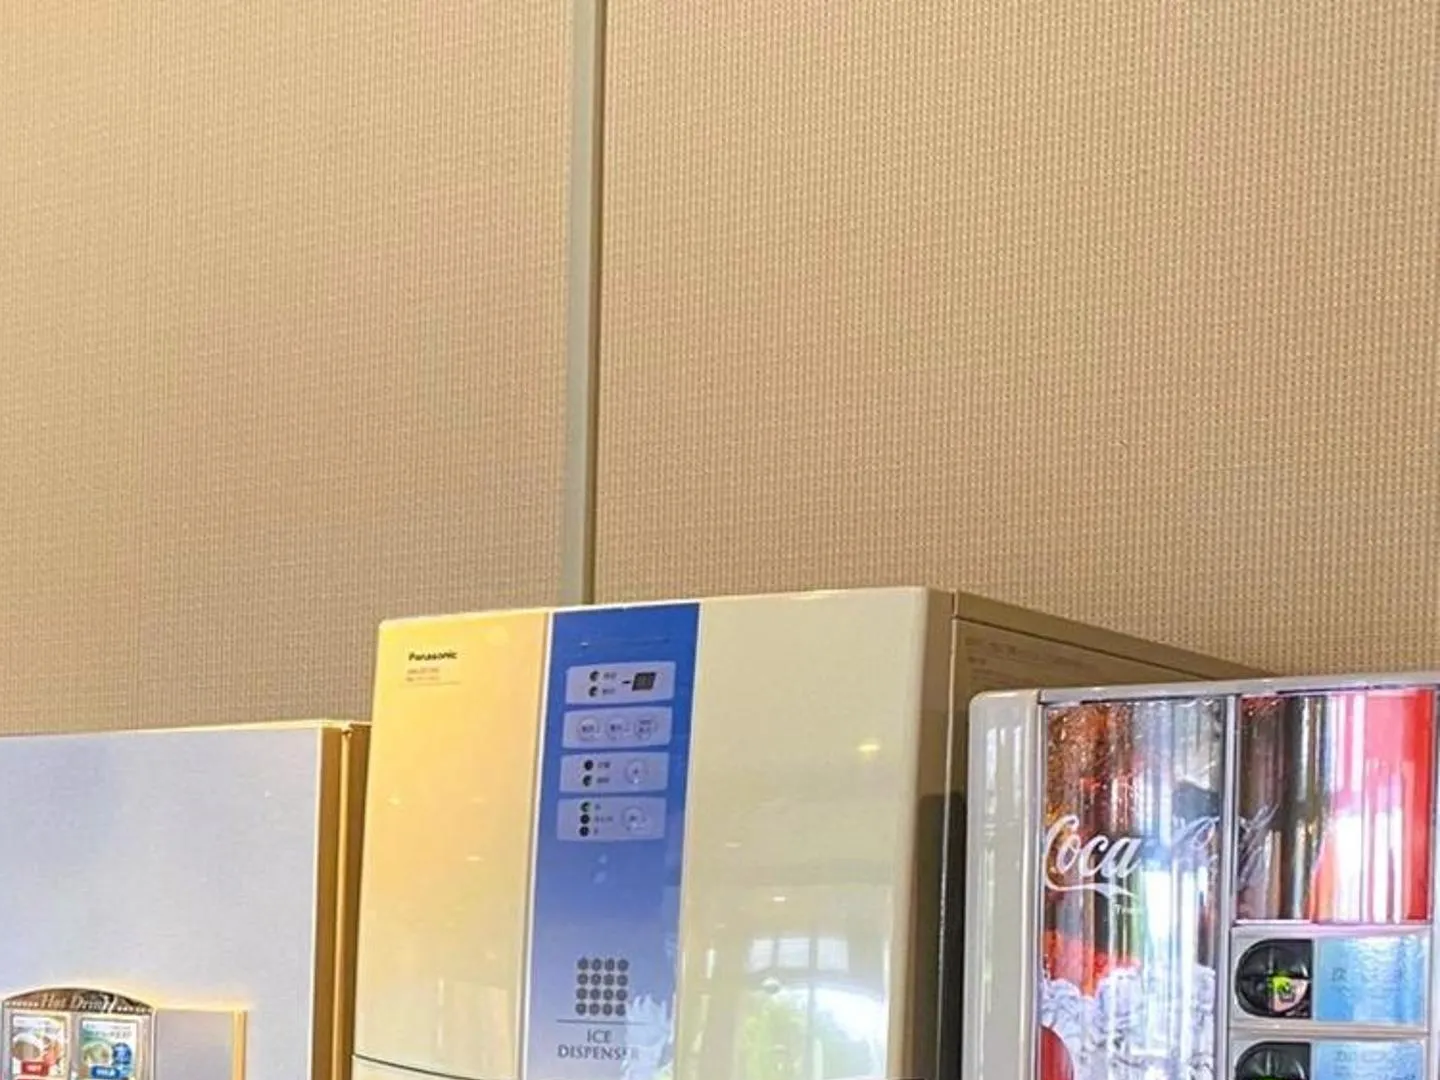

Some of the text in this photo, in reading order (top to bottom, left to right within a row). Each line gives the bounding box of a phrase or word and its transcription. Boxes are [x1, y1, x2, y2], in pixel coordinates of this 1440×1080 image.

[408, 650, 458, 661] Panasonic
[587, 1028, 613, 1044] ICE
[557, 1044, 640, 1060] DISPENS
